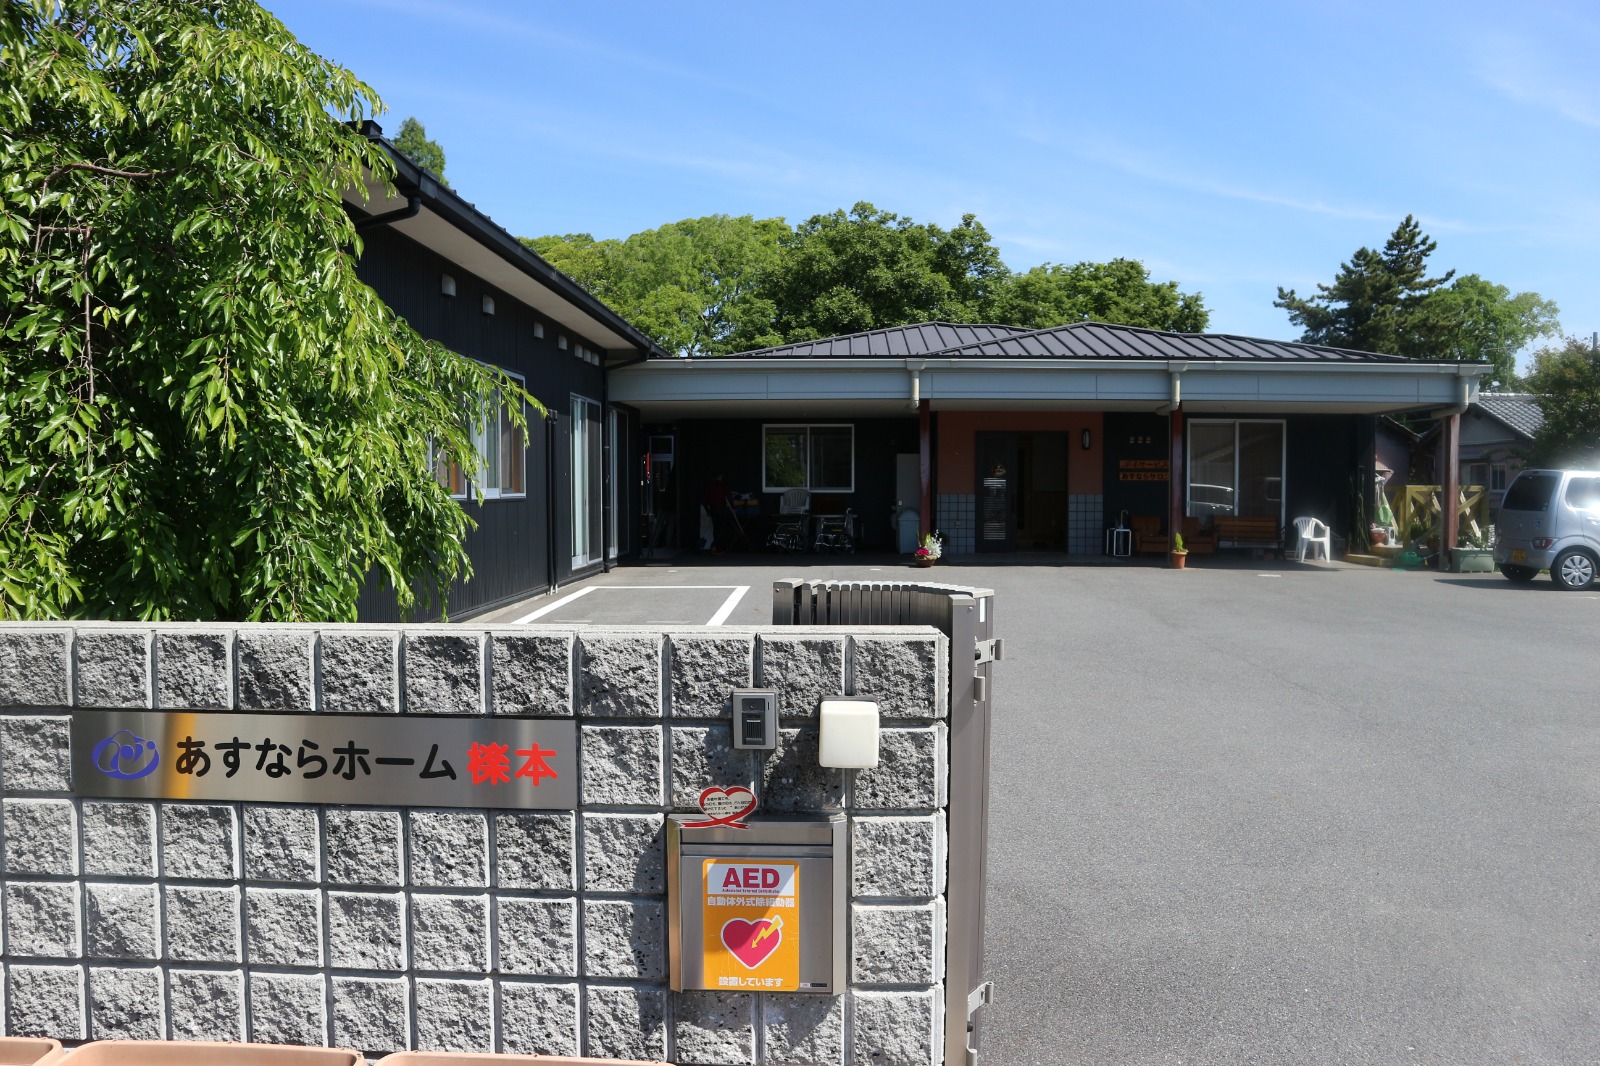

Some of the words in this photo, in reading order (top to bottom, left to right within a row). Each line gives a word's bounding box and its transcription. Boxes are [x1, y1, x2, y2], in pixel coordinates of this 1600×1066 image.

[722, 867, 780, 888] AED
[707, 896, 795, 907] 自動体外式除細動器
[718, 976, 784, 987] 設置しています
